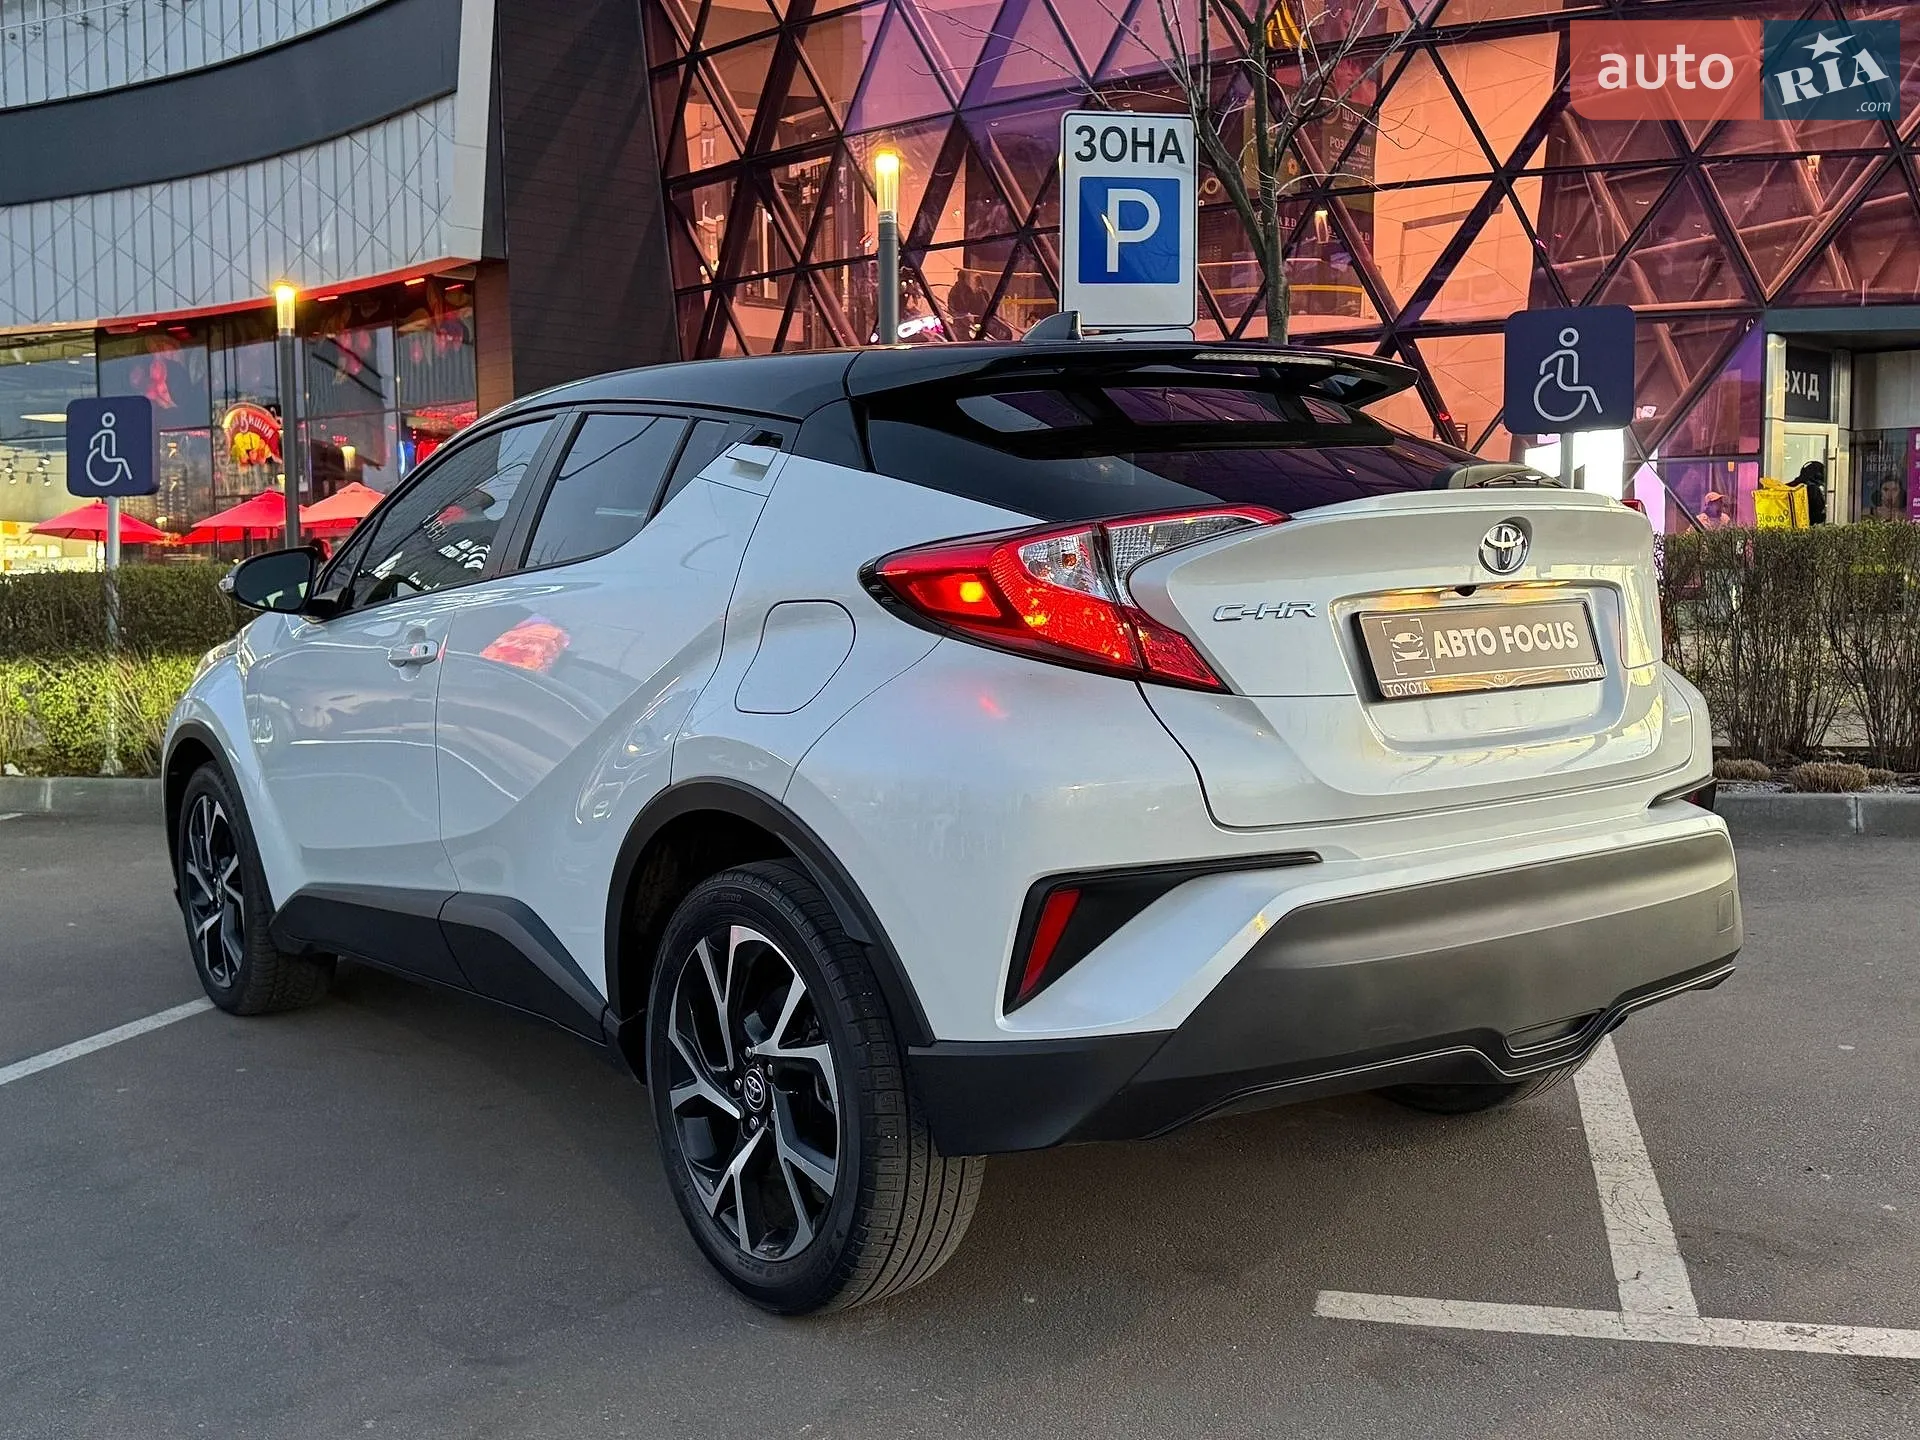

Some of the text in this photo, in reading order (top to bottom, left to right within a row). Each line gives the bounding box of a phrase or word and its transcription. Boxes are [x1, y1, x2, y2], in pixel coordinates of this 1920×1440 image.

[1075, 125, 1185, 165] ЗОНА
[1106, 188, 1161, 273] P
[1213, 600, 1318, 623] C-HR
[1433, 622, 1579, 660] АВТО FOCUS
[1566, 665, 1603, 680] TOYOTA
[1387, 681, 1430, 696] TOYOTA
